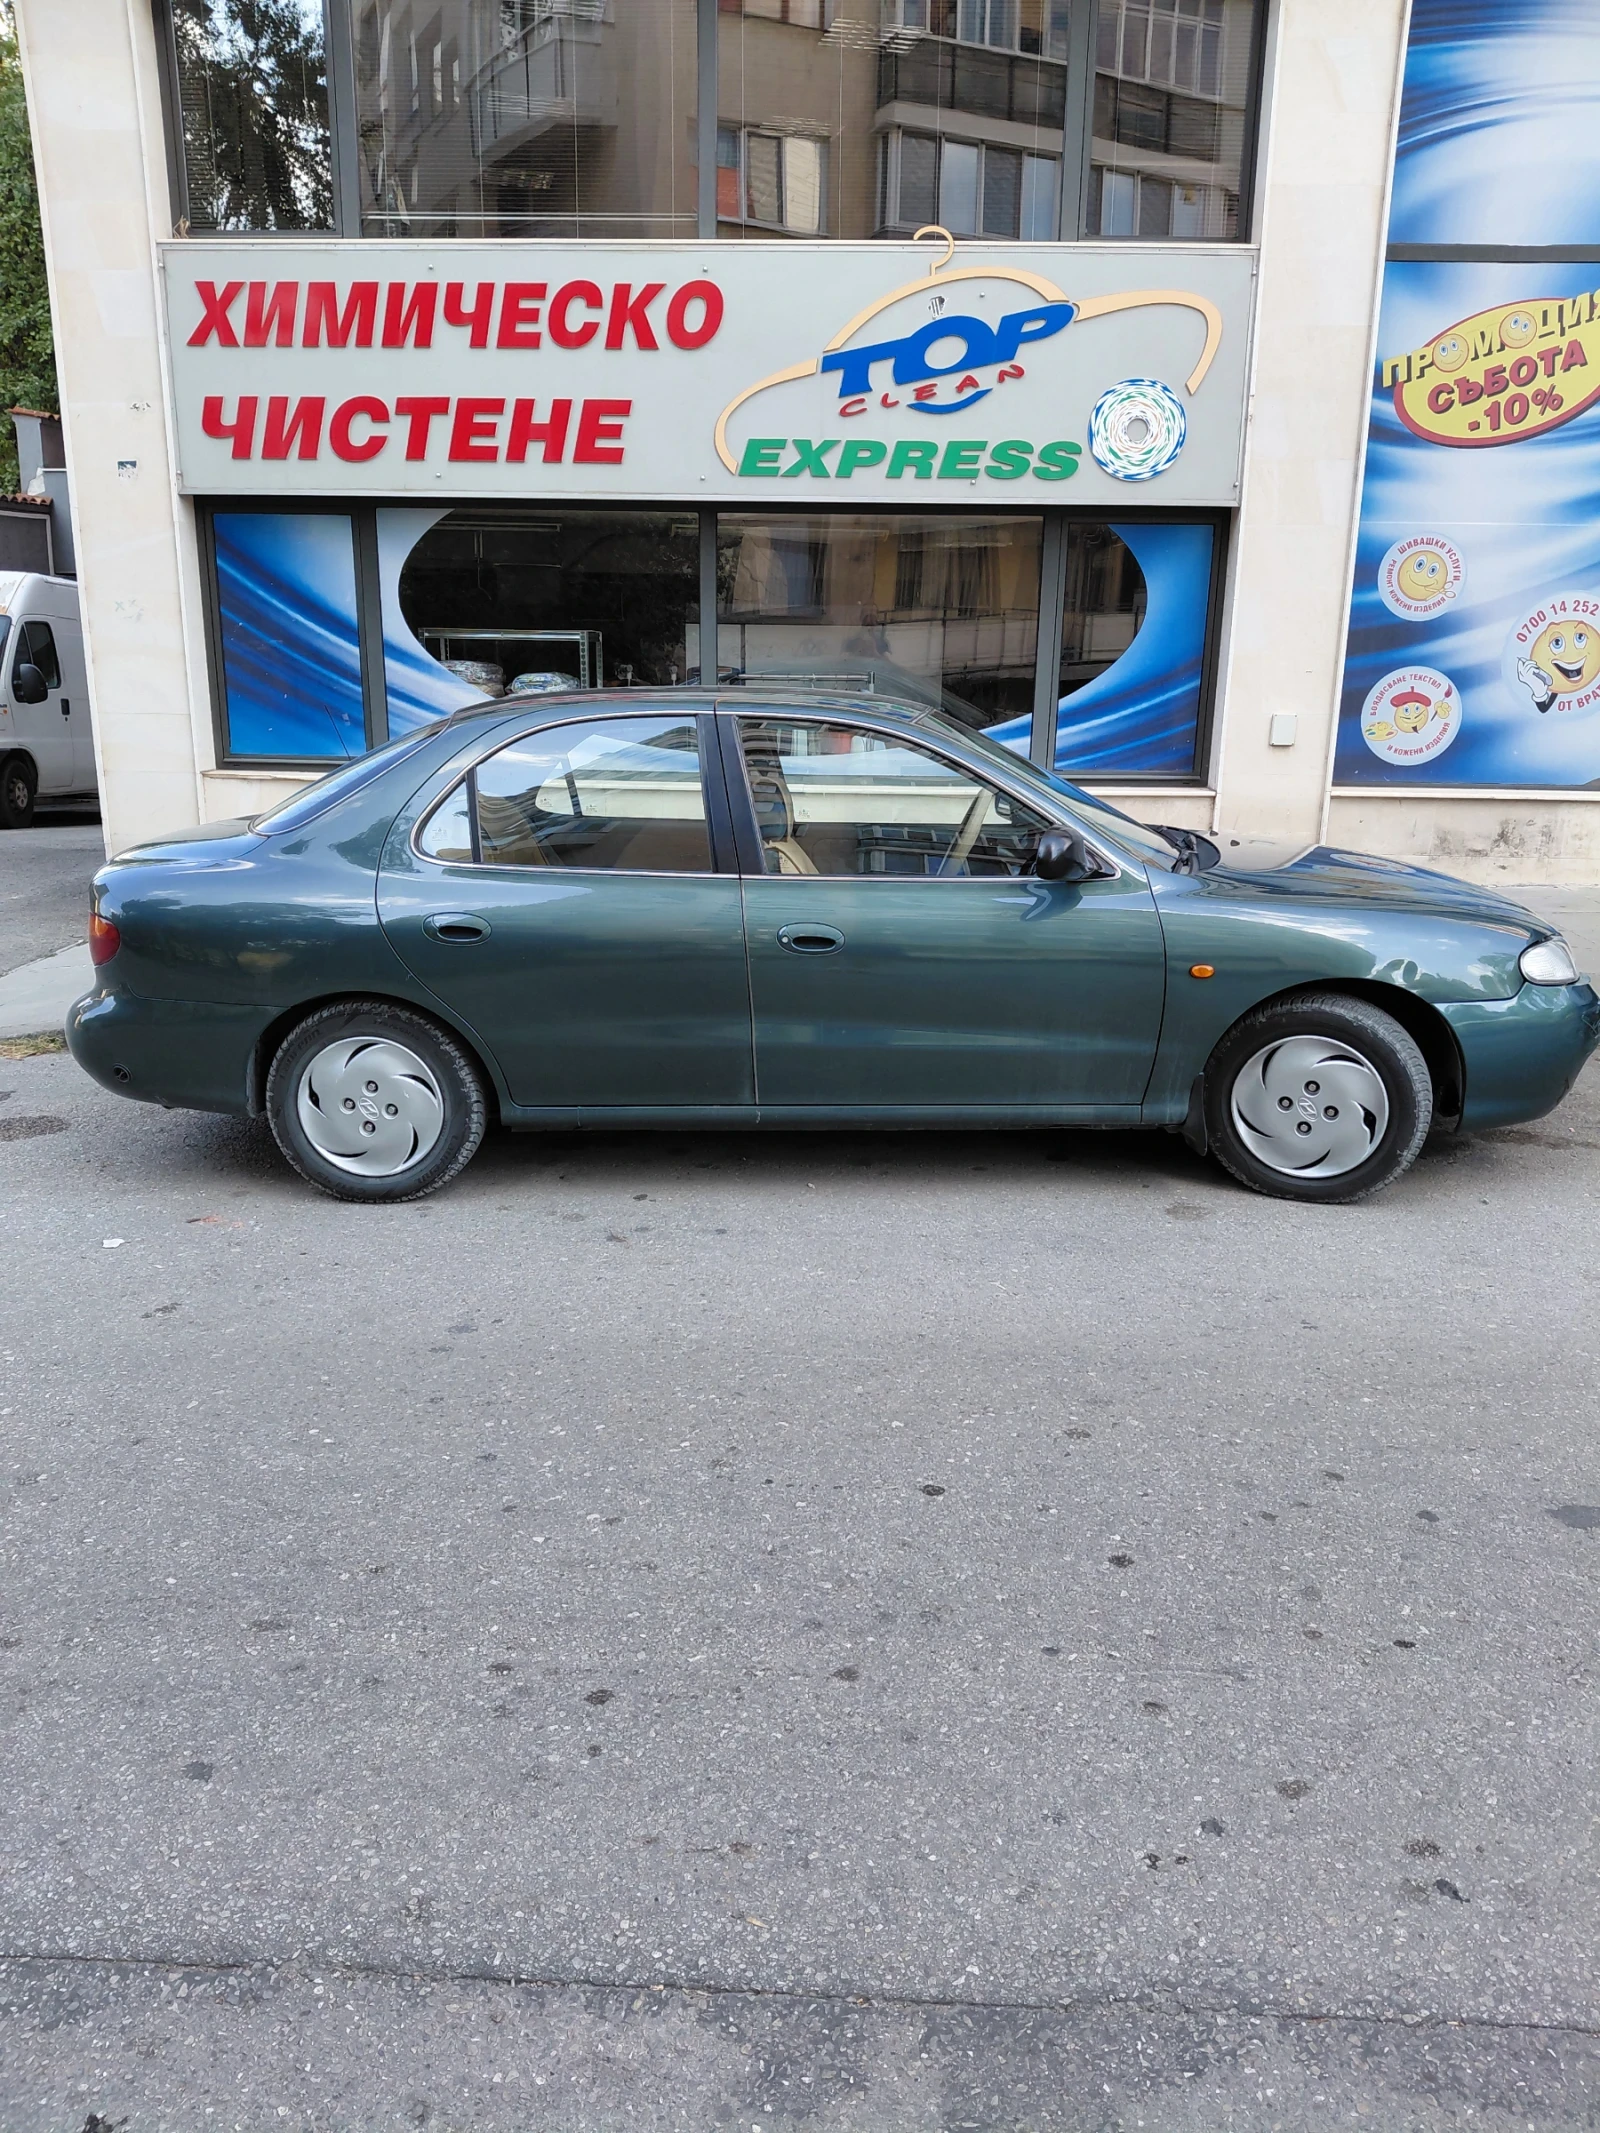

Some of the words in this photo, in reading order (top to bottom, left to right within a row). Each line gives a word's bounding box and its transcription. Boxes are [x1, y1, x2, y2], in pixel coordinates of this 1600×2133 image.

[187, 279, 725, 351] ХИМИЧЕСКО
[821, 304, 1075, 398] TOP
[838, 363, 1026, 417] CLEAN
[1427, 339, 1588, 414] СЪБОТА
[201, 395, 633, 464] ЧИСТЕНЕ
[1468, 383, 1564, 432] -10%
[738, 438, 1083, 480] EXPRESS
[1386, 559, 1398, 588] РЕМОНТ
[1397, 537, 1447, 555] ШИВАШКИ
[1445, 547, 1462, 581] УСЛУГИ
[1389, 589, 1412, 612] КОЖЕНИ
[1413, 596, 1447, 613] ИЗДЕЛИЯ
[1516, 610, 1547, 643] 0700
[1550, 600, 1567, 615] 14
[1572, 599, 1600, 616] 252
[1370, 675, 1407, 716] БОЯДИСВАНЕ
[1409, 673, 1442, 690] ТЕКСТИЛ
[1557, 700, 1573, 711] ОТ
[1393, 747, 1424, 756] КОЖЕНИ
[1424, 722, 1451, 752] ИЗДЕЛИЯ
